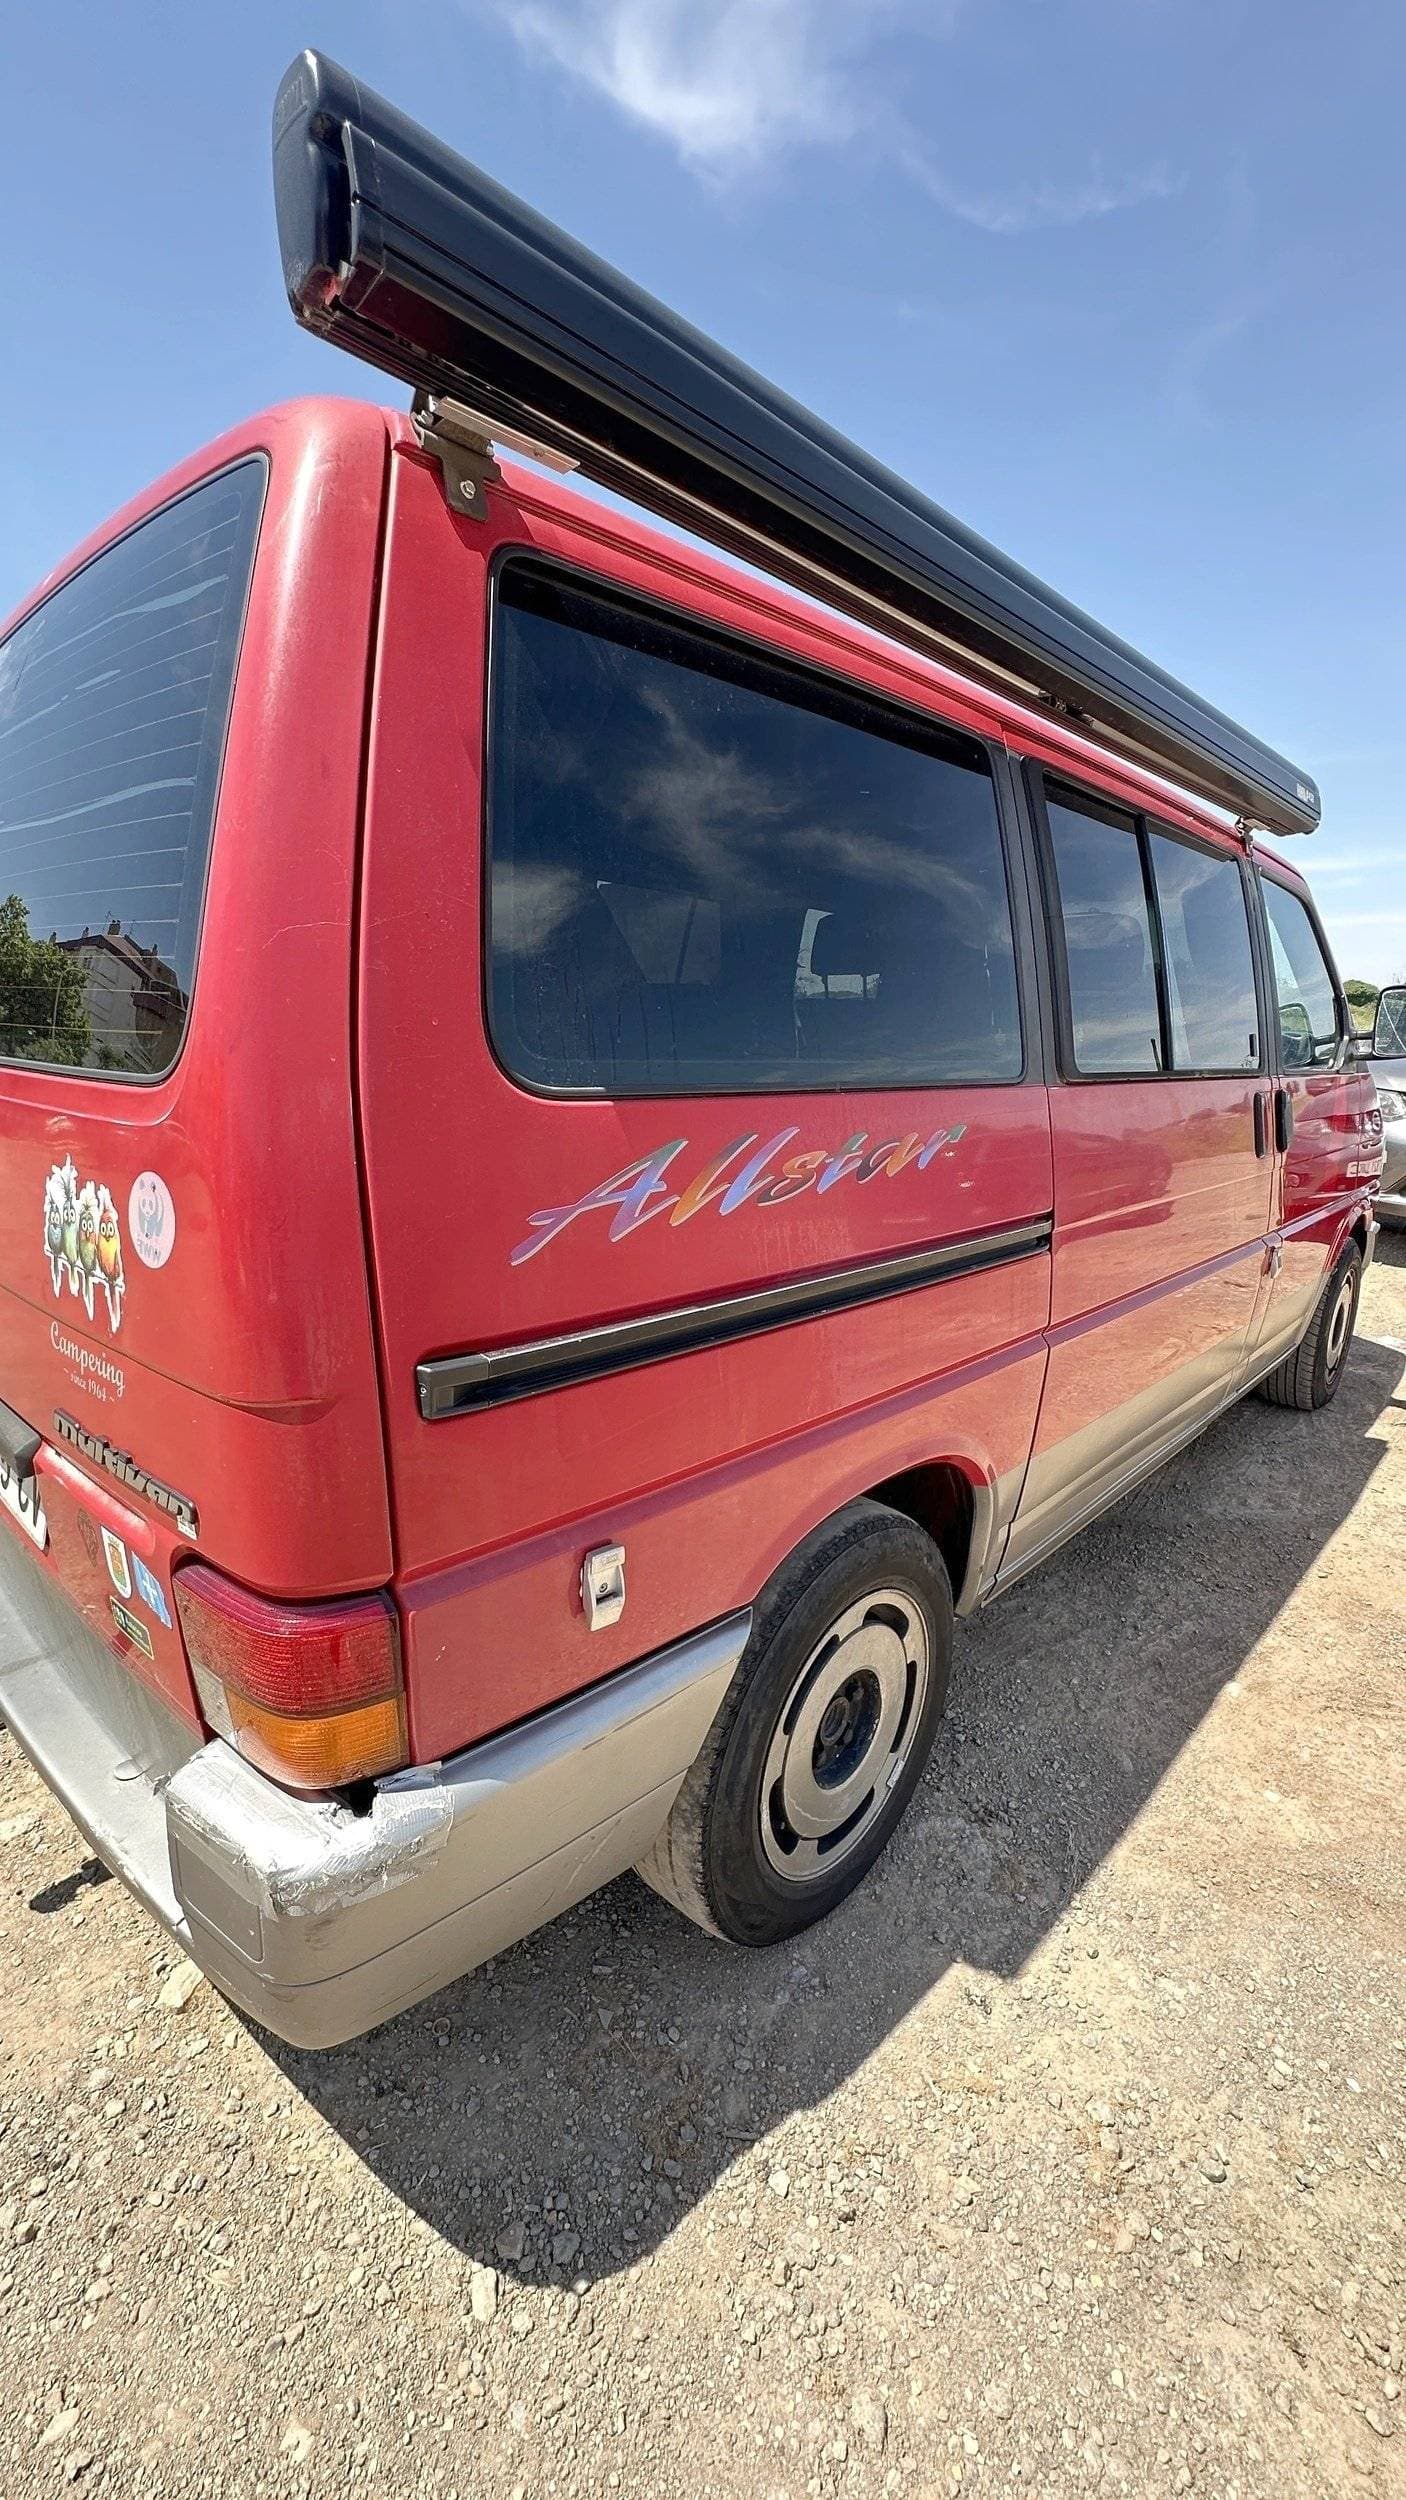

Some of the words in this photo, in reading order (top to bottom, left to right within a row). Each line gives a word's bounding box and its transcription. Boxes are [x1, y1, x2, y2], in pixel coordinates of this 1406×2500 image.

[511, 1126, 967, 1266] Allstar
[51, 1321, 125, 1398] Campering
[70, 1370, 87, 1390] since
[53, 1407, 197, 1524] multivan
